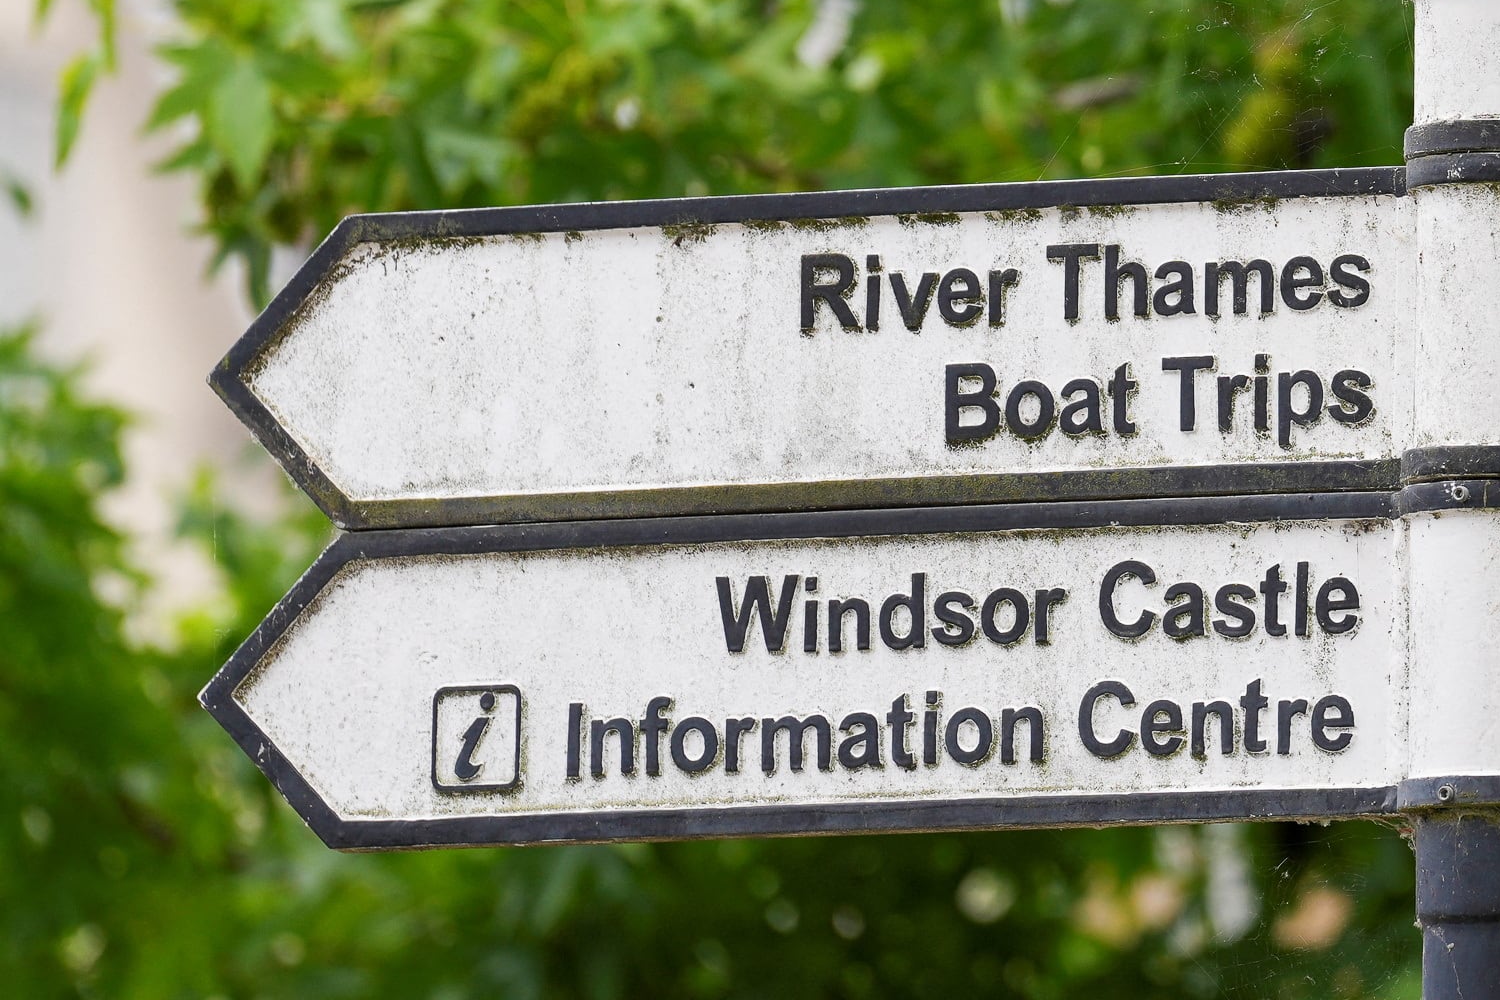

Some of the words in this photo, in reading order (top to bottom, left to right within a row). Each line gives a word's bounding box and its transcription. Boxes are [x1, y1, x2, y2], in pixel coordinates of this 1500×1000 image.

[801, 254, 1018, 335] River
[1048, 244, 1370, 322] Thames
[945, 363, 1137, 445] Boat
[1162, 354, 1373, 449] Trips
[716, 573, 1065, 653] Windsor
[1100, 561, 1360, 640] Castle
[455, 692, 495, 779] i
[567, 691, 1046, 778] Information
[1079, 679, 1354, 759] Centre
